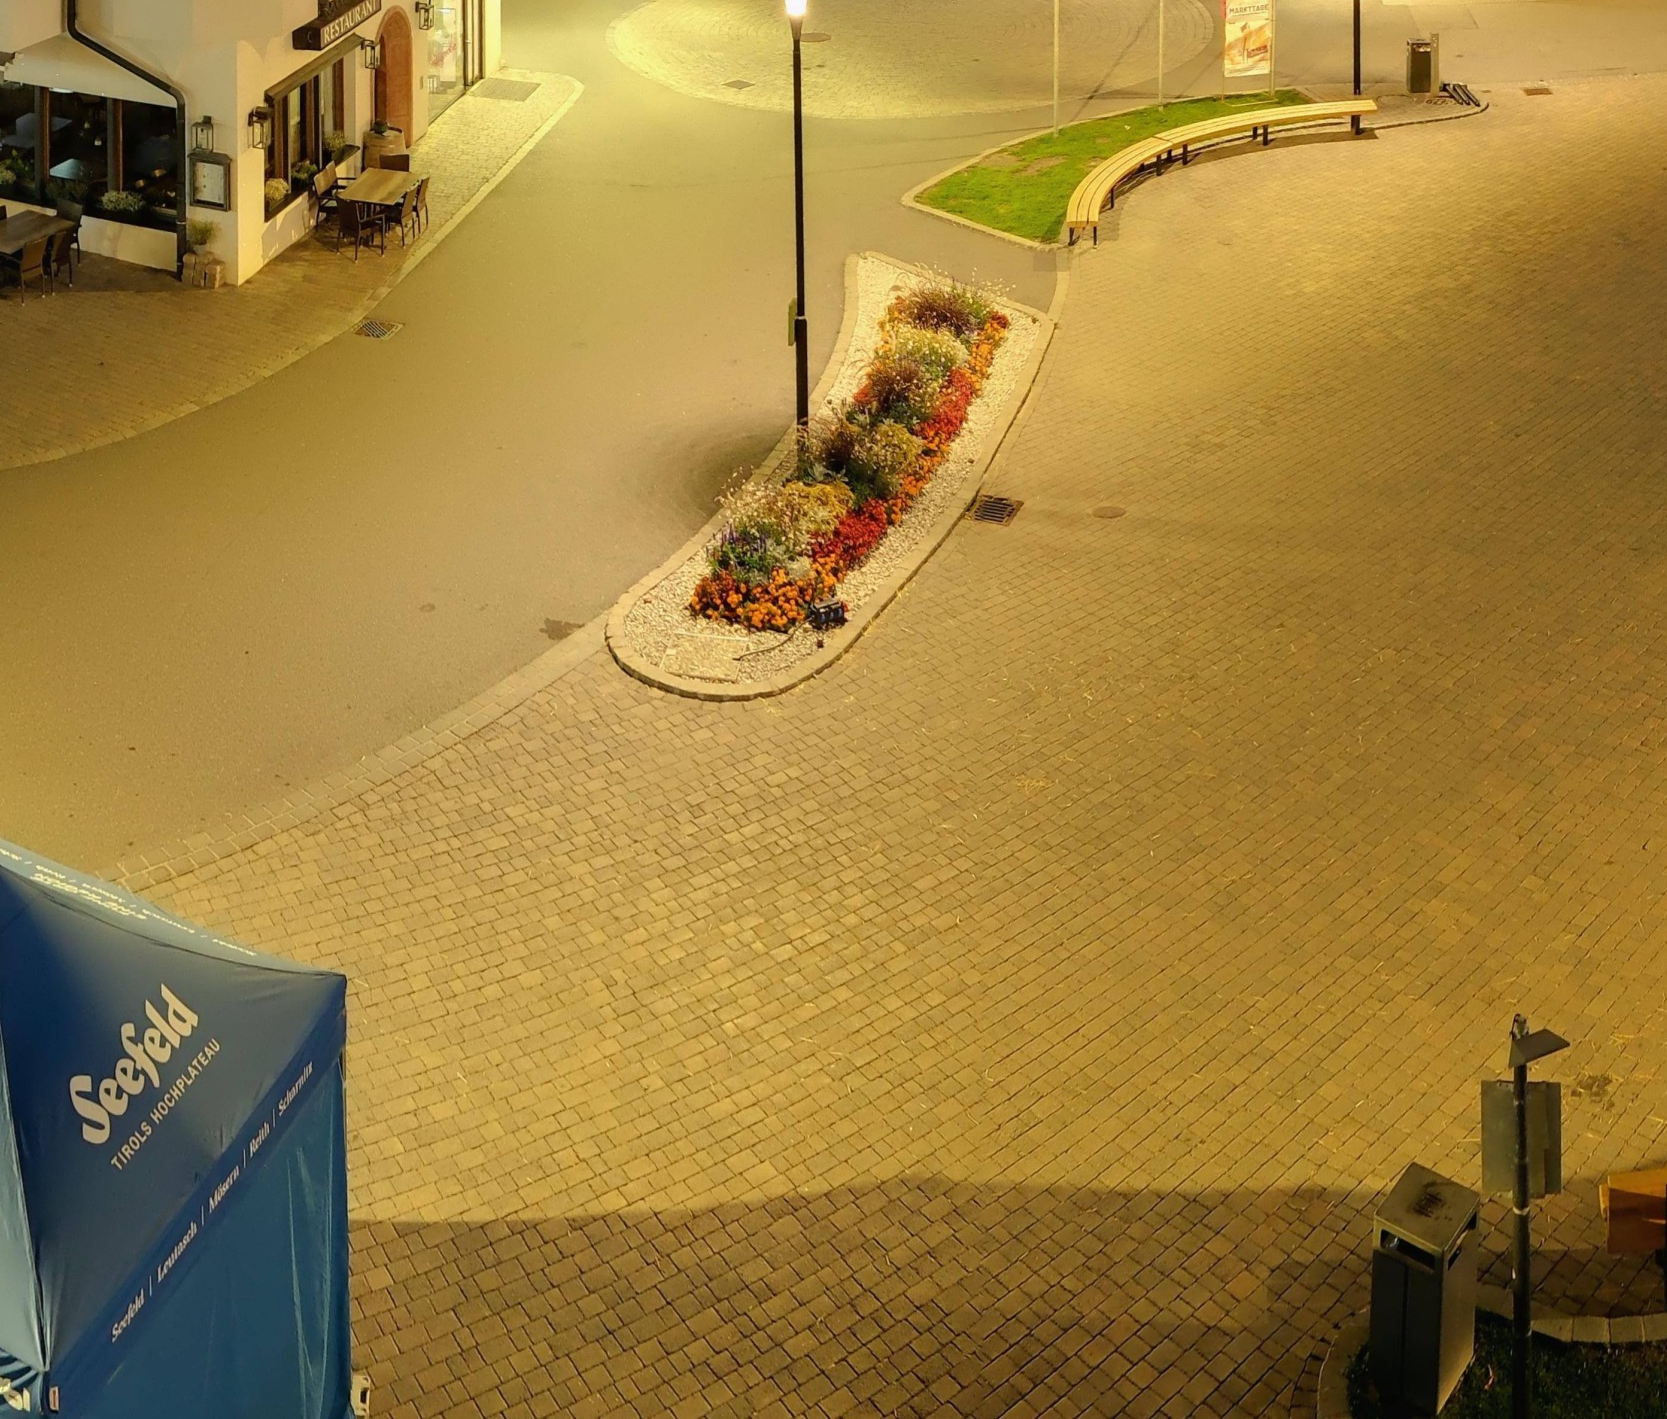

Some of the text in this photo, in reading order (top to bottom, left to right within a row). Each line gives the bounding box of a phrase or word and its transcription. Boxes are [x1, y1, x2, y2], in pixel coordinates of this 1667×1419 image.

[1229, 3, 1269, 14] MARKTTAGE
[69, 983, 199, 1145] Seefeld
[110, 1038, 221, 1171] TIROLS HOCHPLATEAU
[112, 1061, 314, 1343] Seefeld Leutasch Mösern Reith Scharnitz
